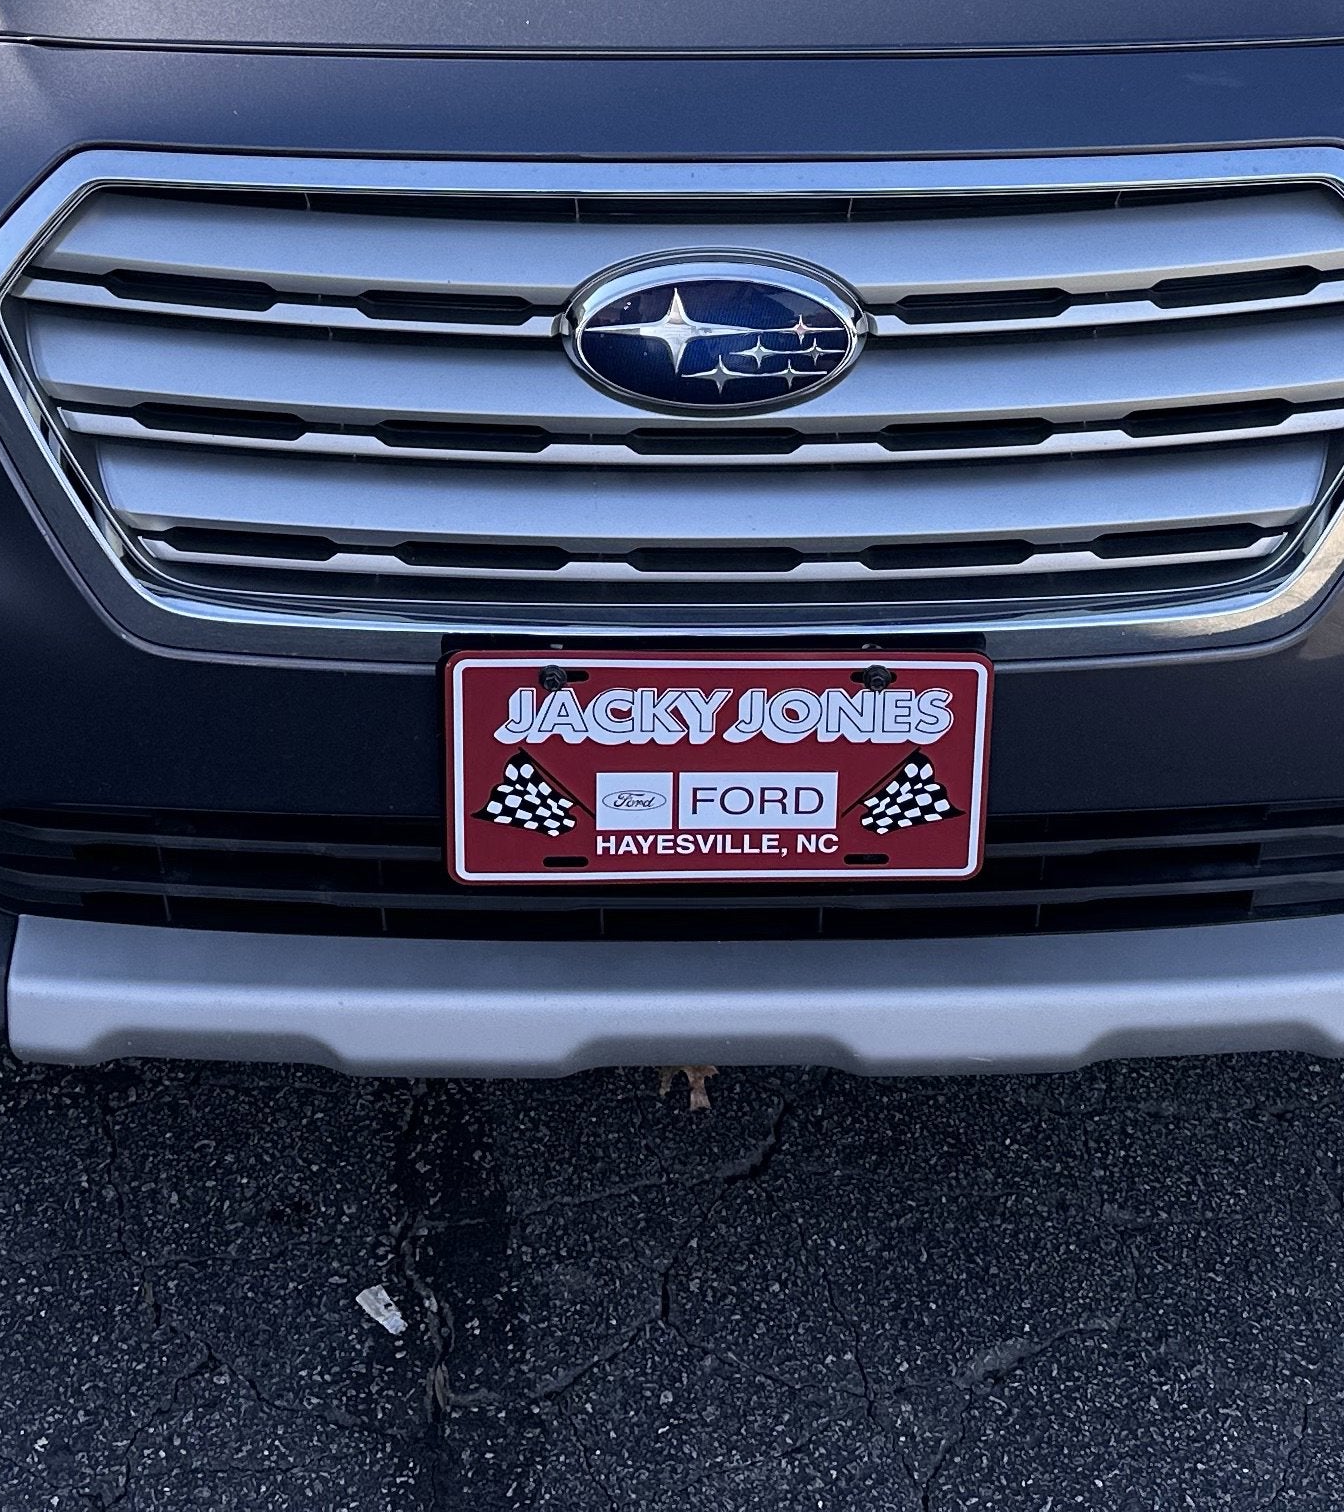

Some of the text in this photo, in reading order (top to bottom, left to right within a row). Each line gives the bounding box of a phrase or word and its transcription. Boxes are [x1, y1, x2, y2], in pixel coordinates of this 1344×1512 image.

[493, 687, 955, 745] JACKY JONES
[613, 786, 825, 815] Ford FORD
[596, 833, 839, 858] HAYESVILLE, NC
